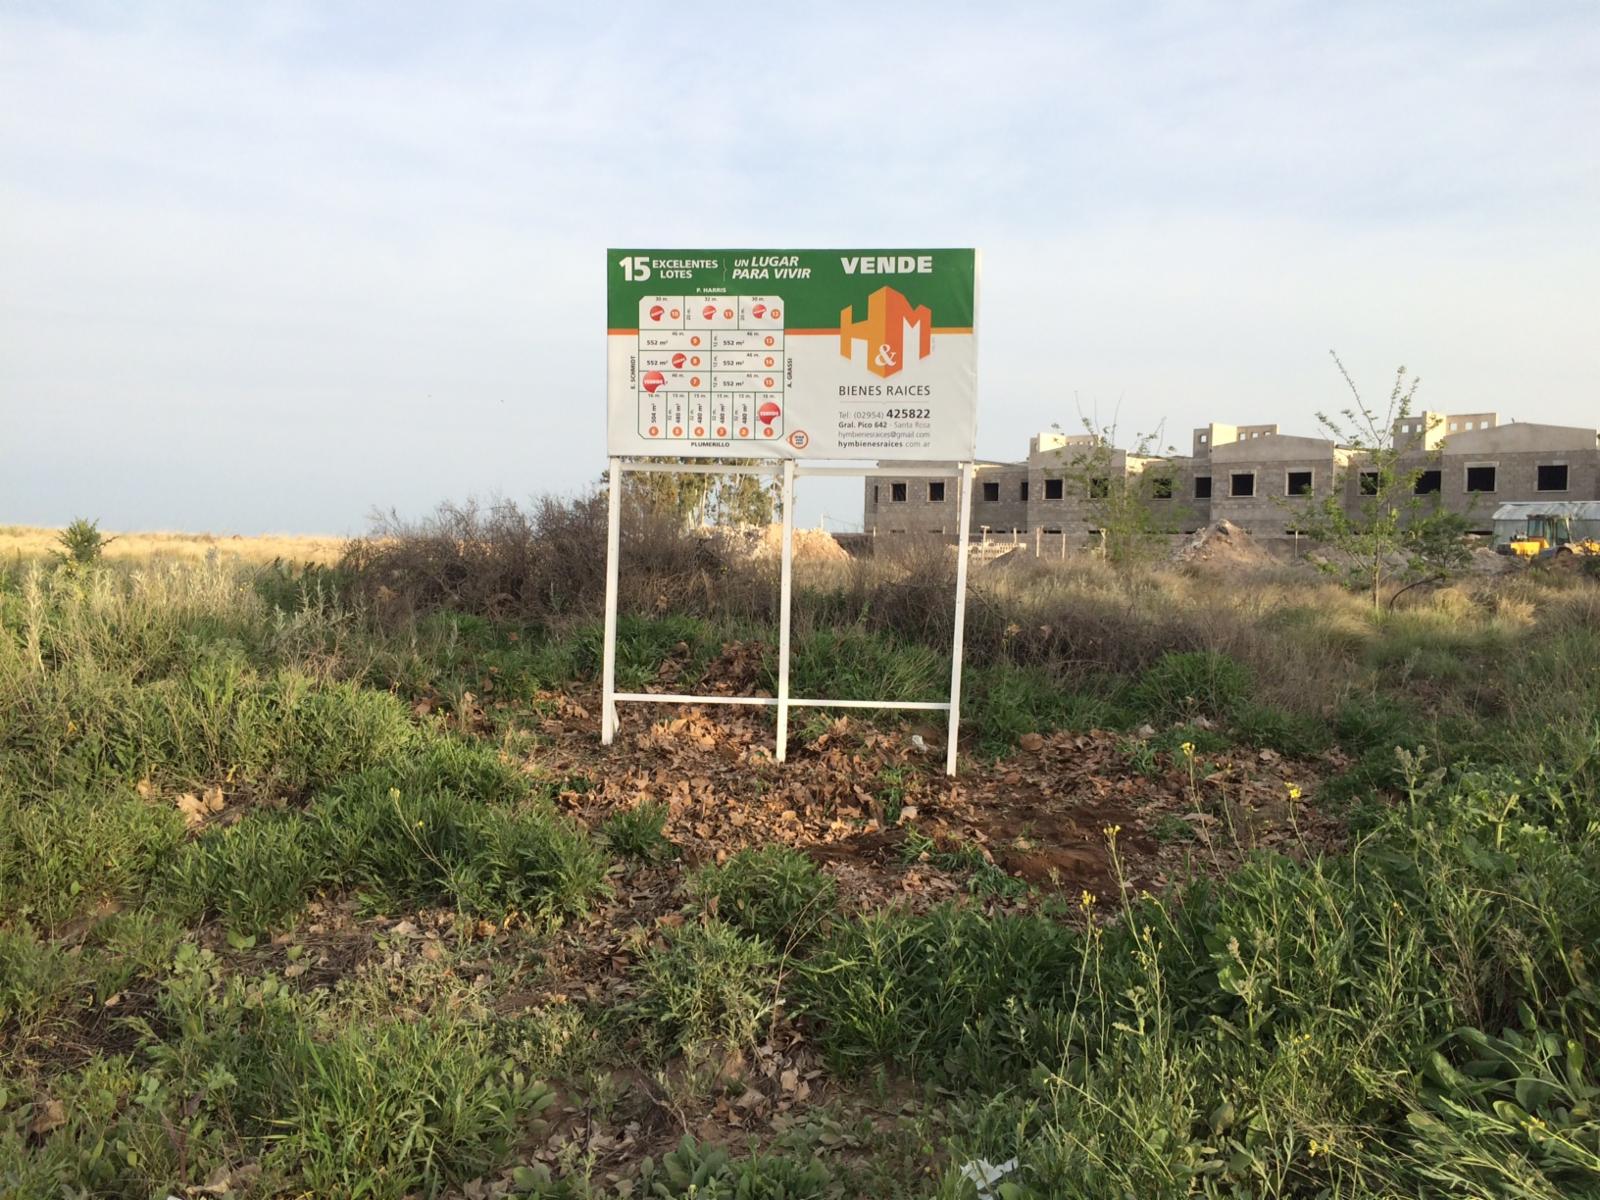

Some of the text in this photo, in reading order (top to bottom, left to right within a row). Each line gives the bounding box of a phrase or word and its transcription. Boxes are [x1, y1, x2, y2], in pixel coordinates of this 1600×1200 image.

[652, 260, 718, 269] EXCELENTES
[734, 256, 799, 267] UN LUGAR
[840, 256, 932, 274] VENDE
[618, 256, 650, 281] 15
[732, 268, 812, 280] PARA VIVIR
[660, 270, 692, 279] LOTES
[839, 386, 930, 396] BIENES RAICES
[854, 411, 884, 420] (02954)
[886, 409, 930, 418] 425822
